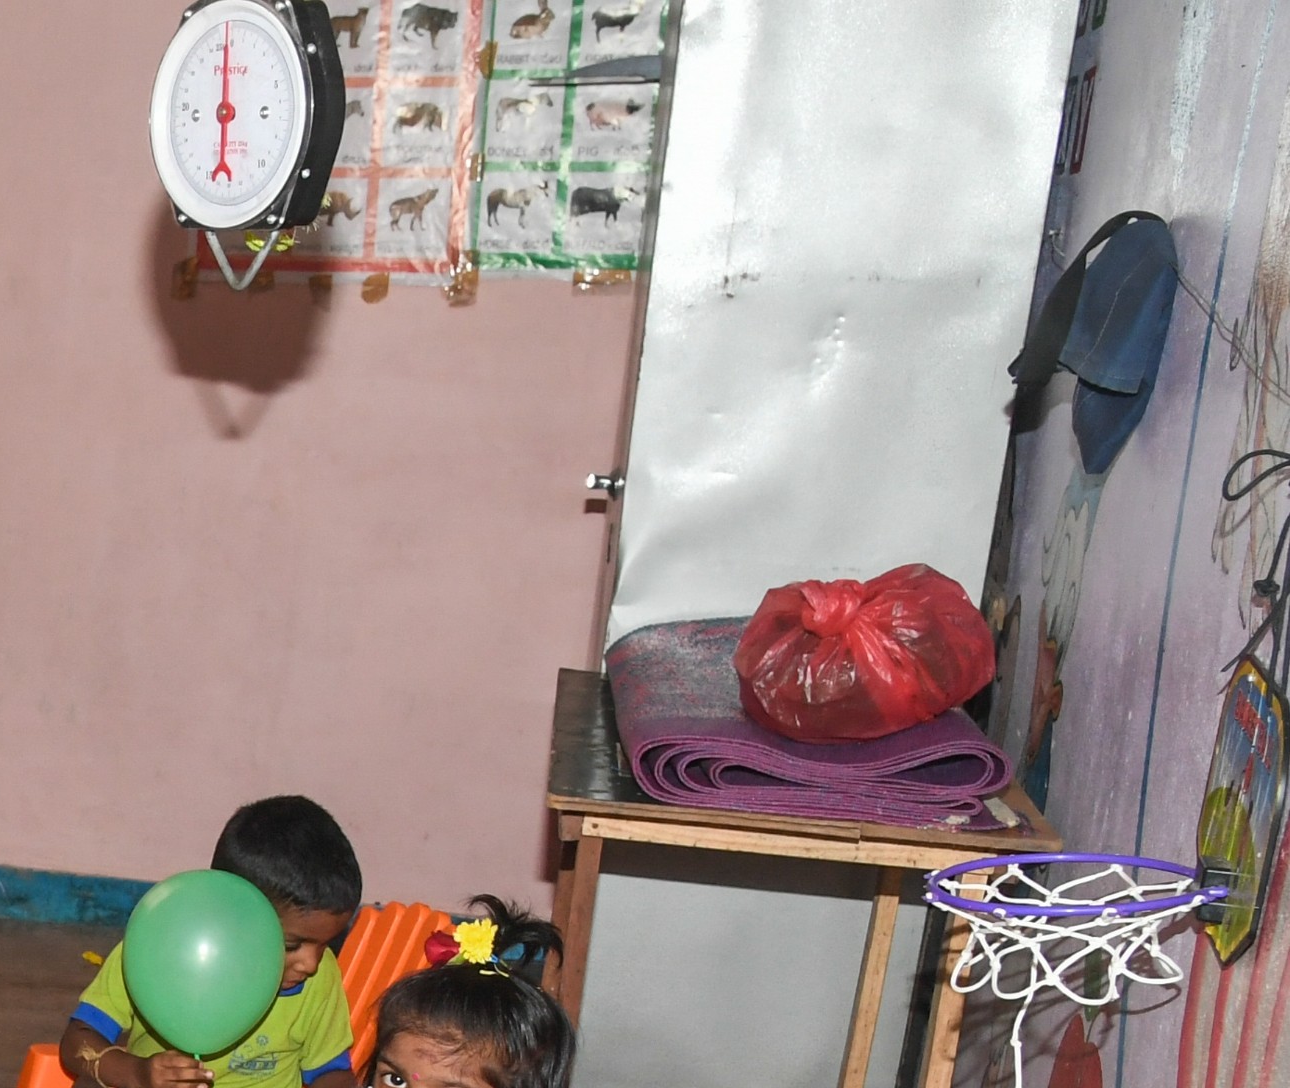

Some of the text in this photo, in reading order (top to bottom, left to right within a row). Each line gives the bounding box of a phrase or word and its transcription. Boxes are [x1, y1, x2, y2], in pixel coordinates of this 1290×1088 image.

[181, 102, 190, 112] 20
[577, 146, 599, 157] PIG
[257, 159, 266, 169] 10
